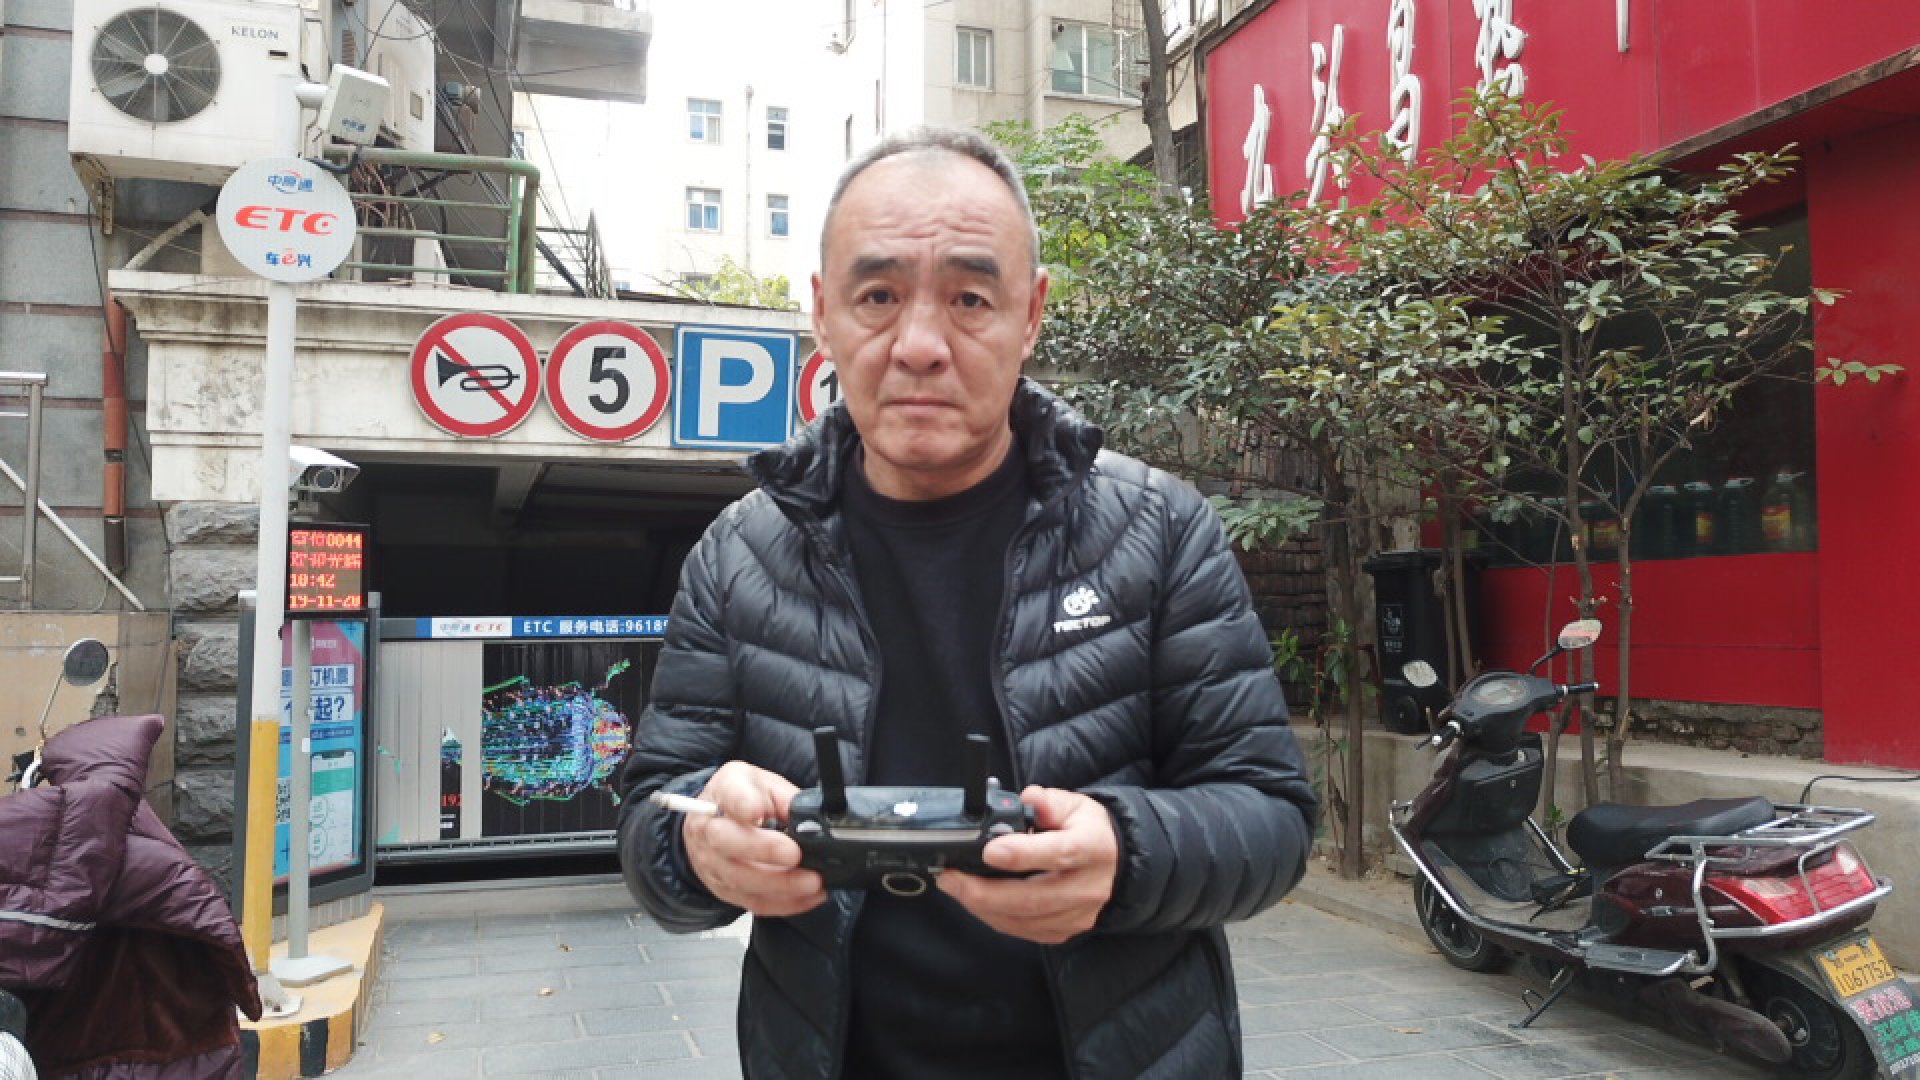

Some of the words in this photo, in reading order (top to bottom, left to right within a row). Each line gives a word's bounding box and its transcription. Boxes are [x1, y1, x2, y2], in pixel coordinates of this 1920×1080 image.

[231, 26, 279, 40] KELON
[267, 174, 314, 193] 中原通
[235, 206, 337, 236] ETC
[588, 347, 630, 415] 5
[698, 338, 774, 437] P
[523, 619, 553, 633] ETC
